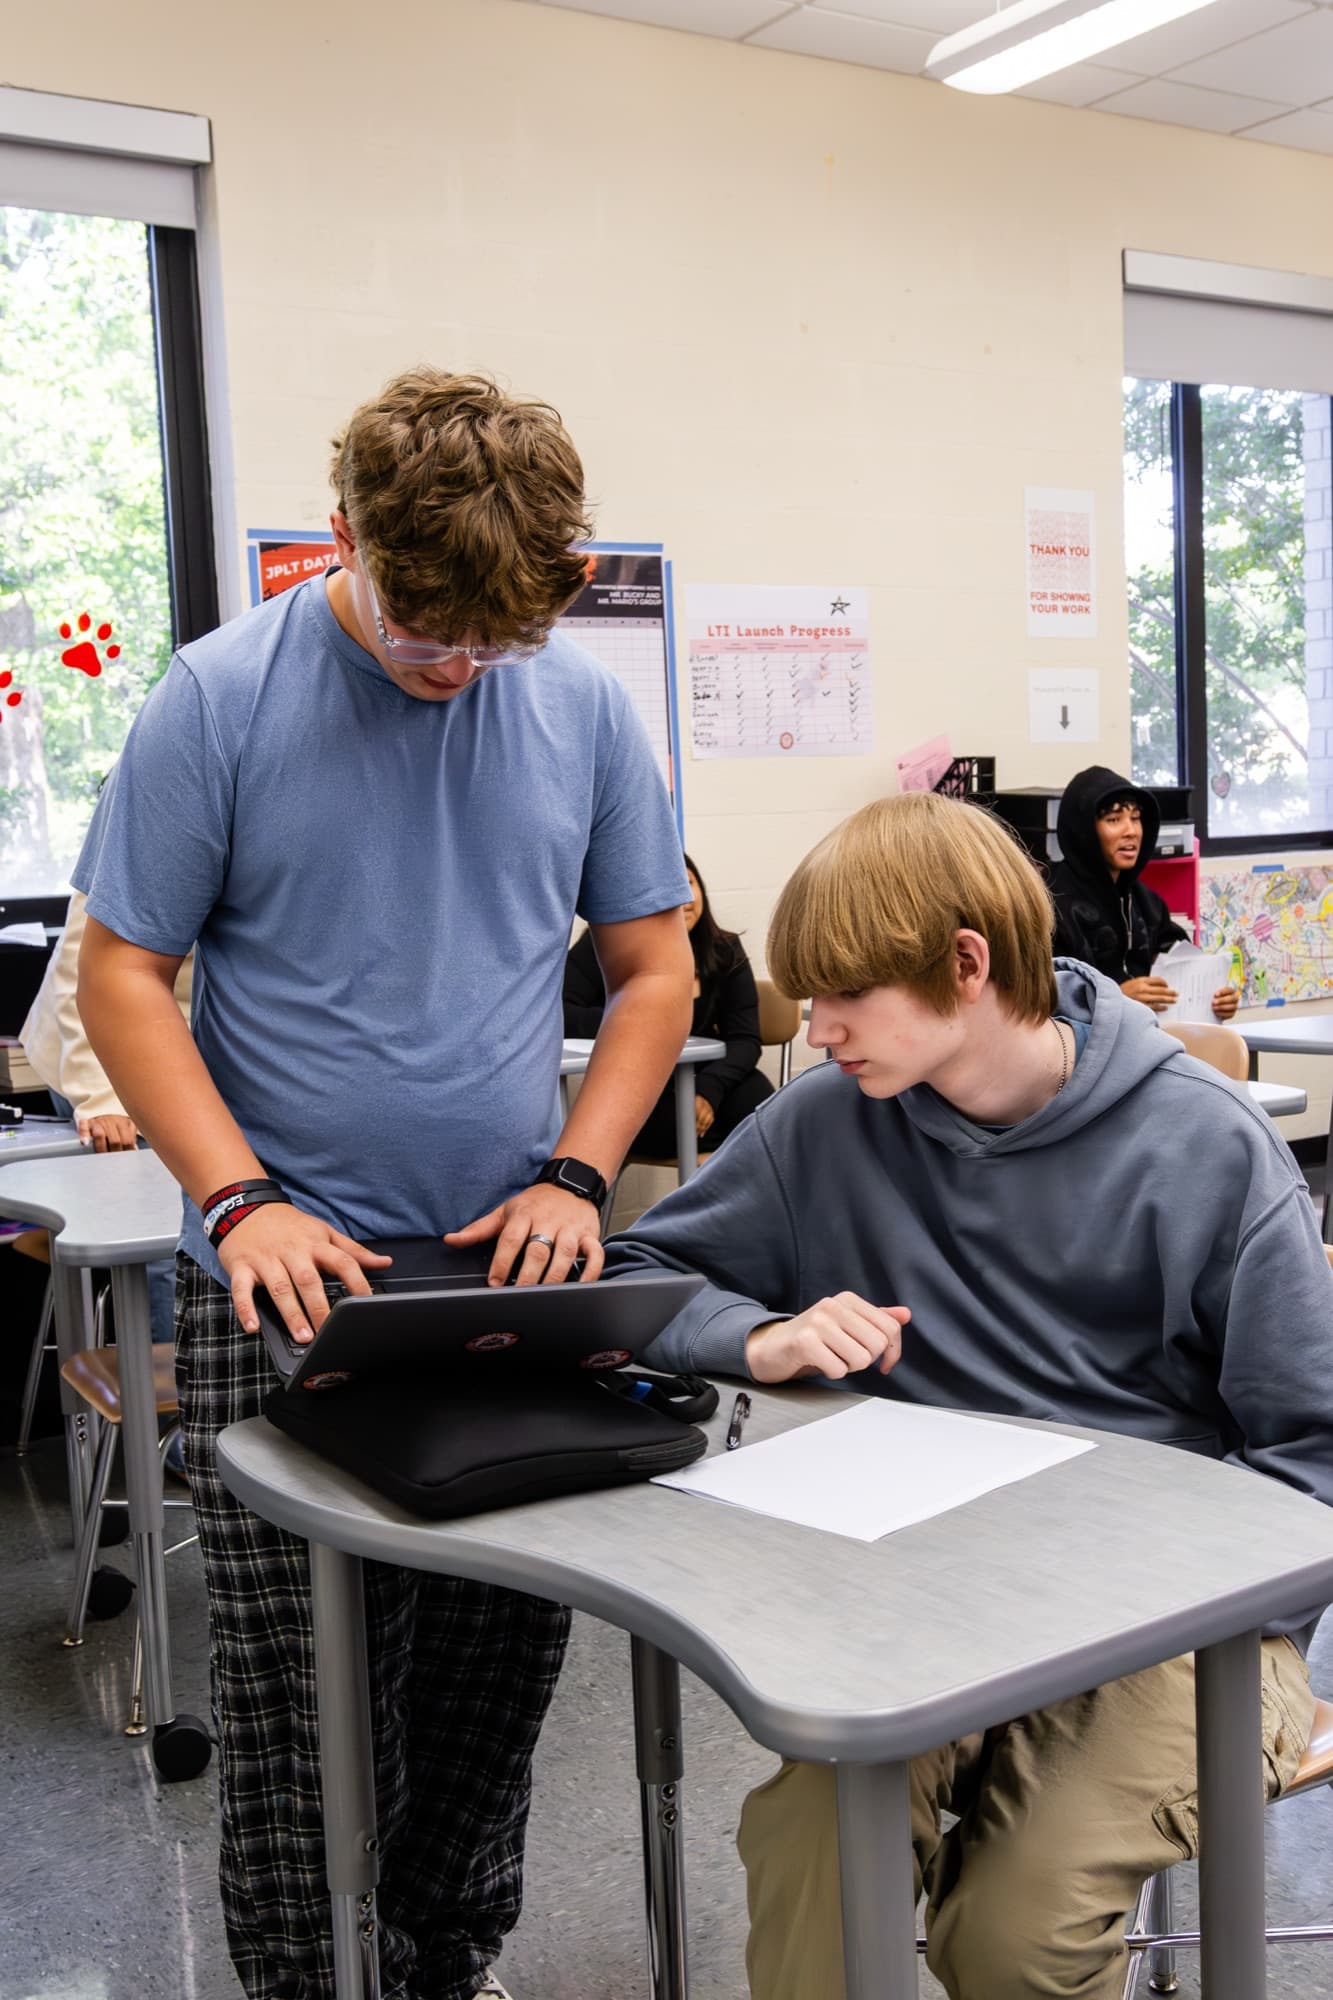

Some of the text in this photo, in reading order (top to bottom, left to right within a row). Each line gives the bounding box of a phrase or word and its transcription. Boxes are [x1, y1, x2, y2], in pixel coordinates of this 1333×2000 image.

[1030, 544, 1090, 557] THANK YOU
[265, 560, 300, 579] JPLT
[1030, 591, 1091, 602] FOR SHOWING
[1030, 604, 1091, 614] YOUR WORK
[707, 625, 852, 640] LTI Launch Progress
